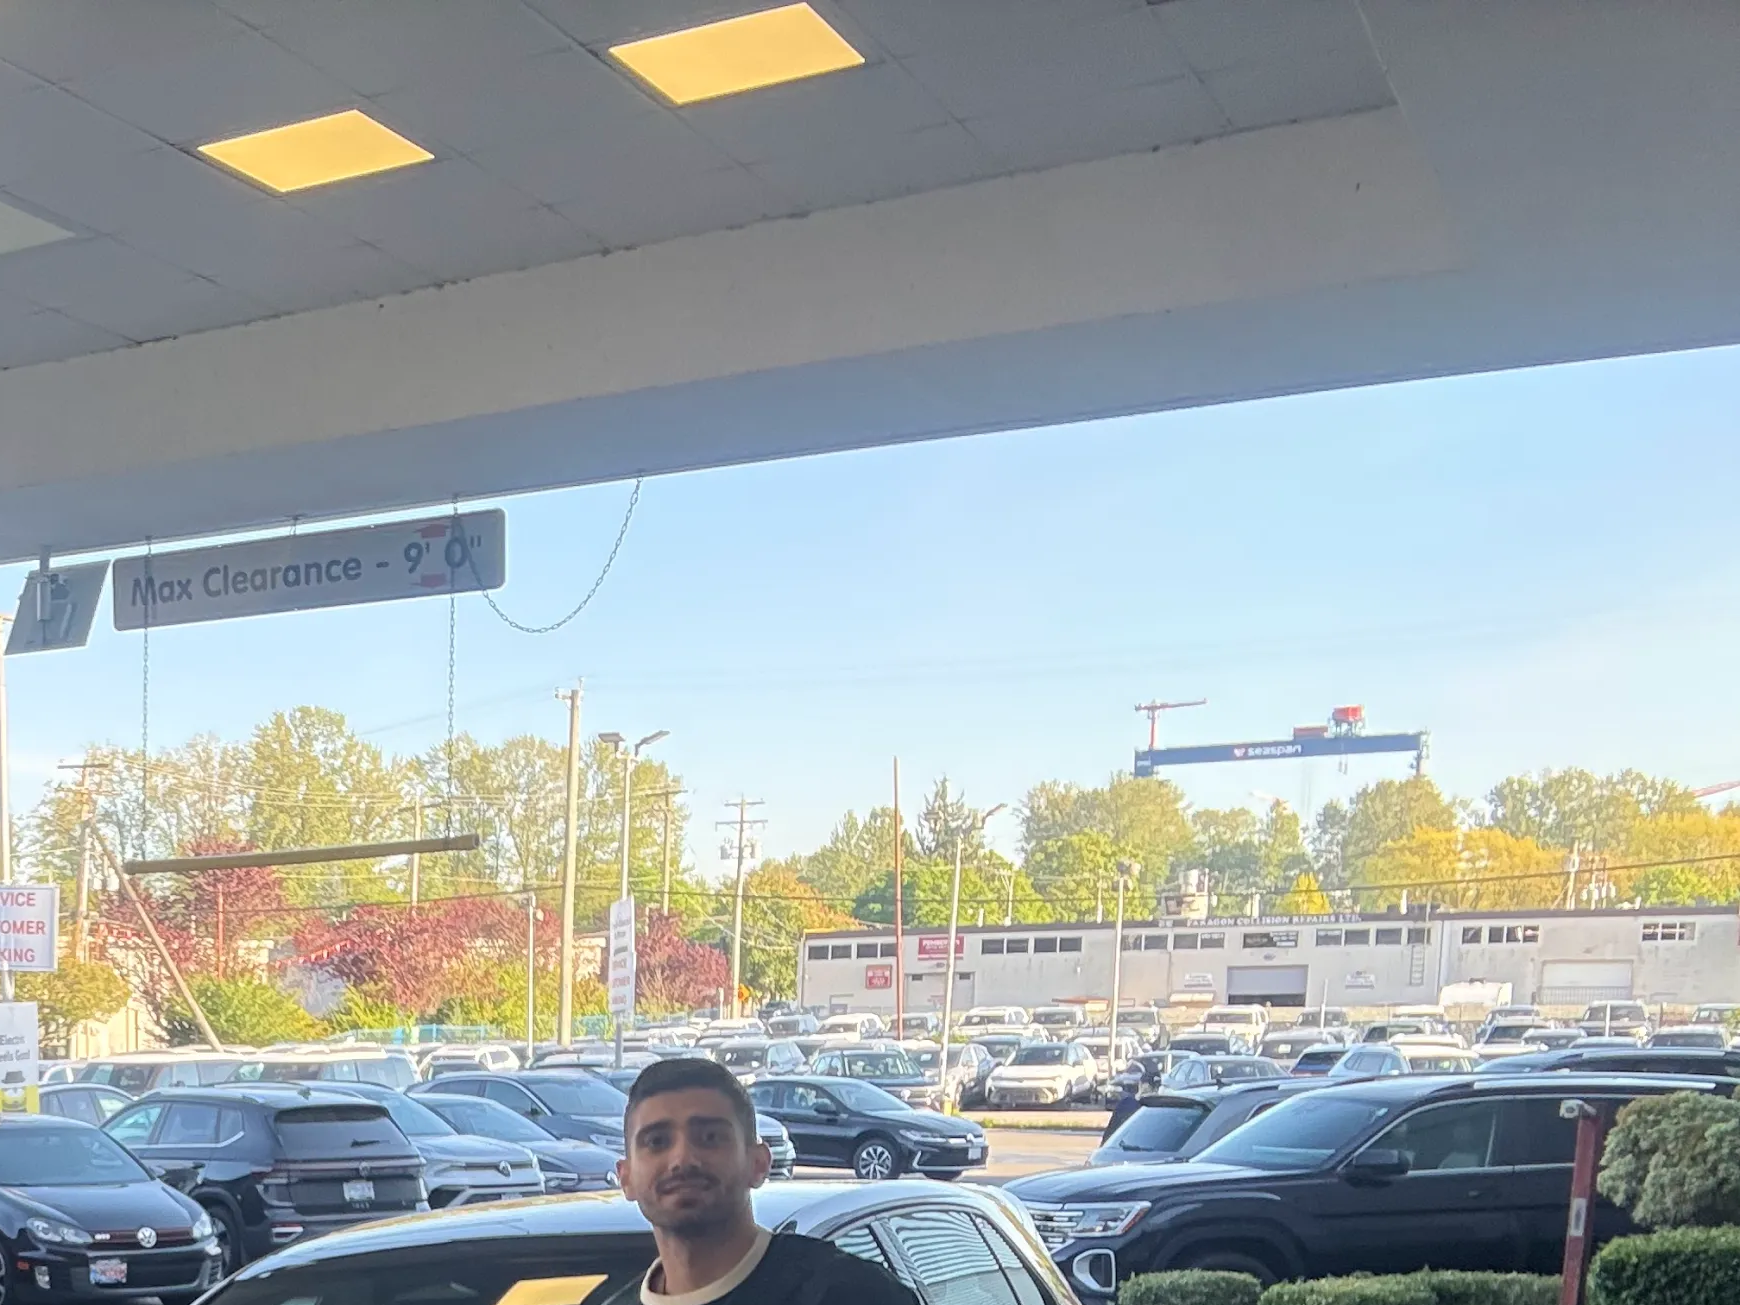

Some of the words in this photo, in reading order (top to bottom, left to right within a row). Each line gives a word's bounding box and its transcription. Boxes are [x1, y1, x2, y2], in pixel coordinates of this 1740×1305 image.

[131, 576, 193, 606] Max
[203, 556, 363, 597] Clearance
[1247, 744, 1302, 757] seaspan
